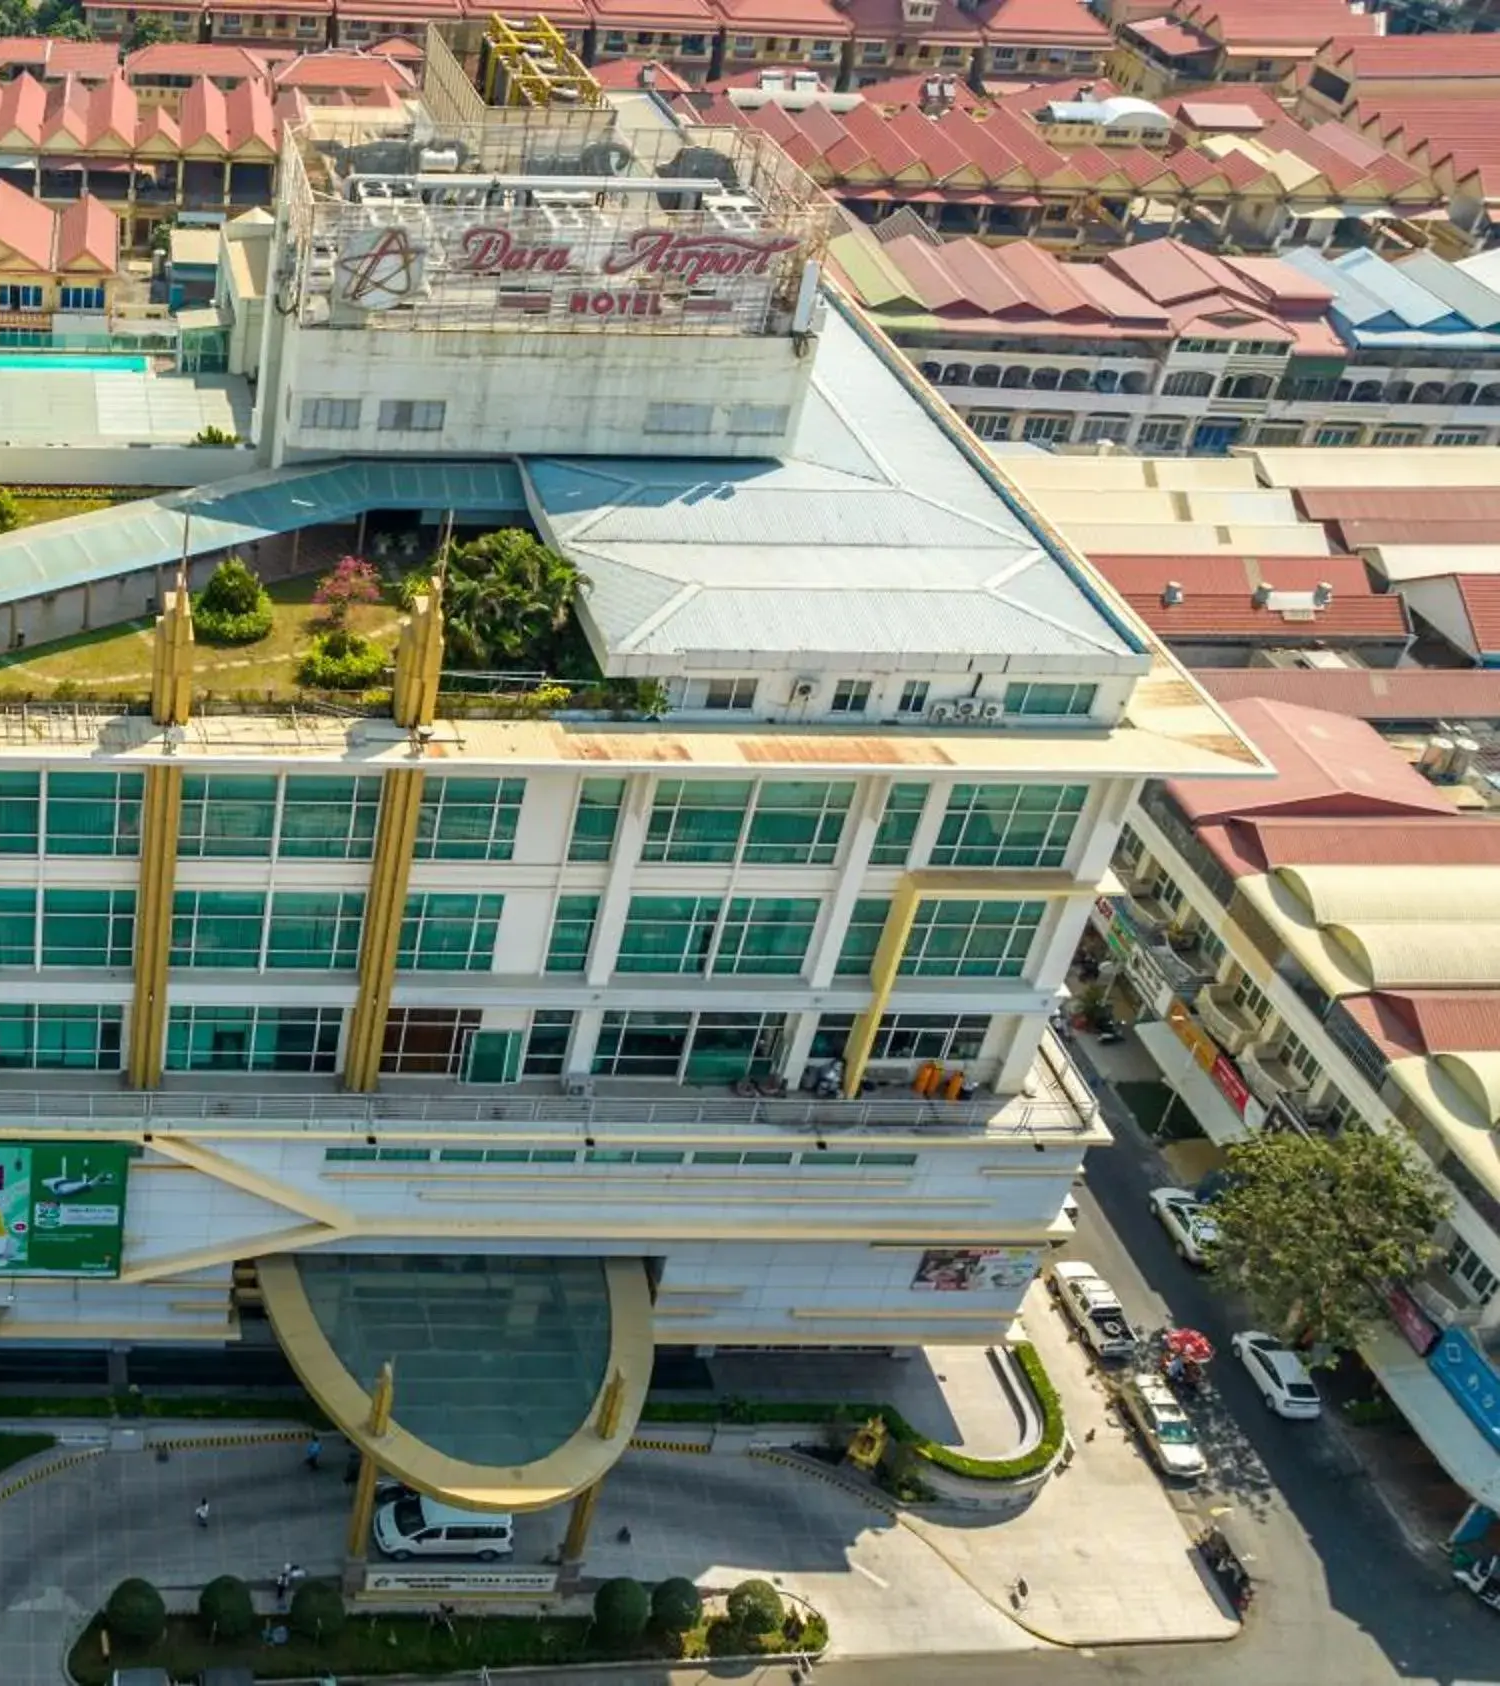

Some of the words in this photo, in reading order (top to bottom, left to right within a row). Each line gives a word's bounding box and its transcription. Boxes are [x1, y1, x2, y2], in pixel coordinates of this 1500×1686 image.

[462, 228, 570, 271] Dara
[605, 231, 800, 285] Airport
[569, 292, 662, 315] HOTEL
